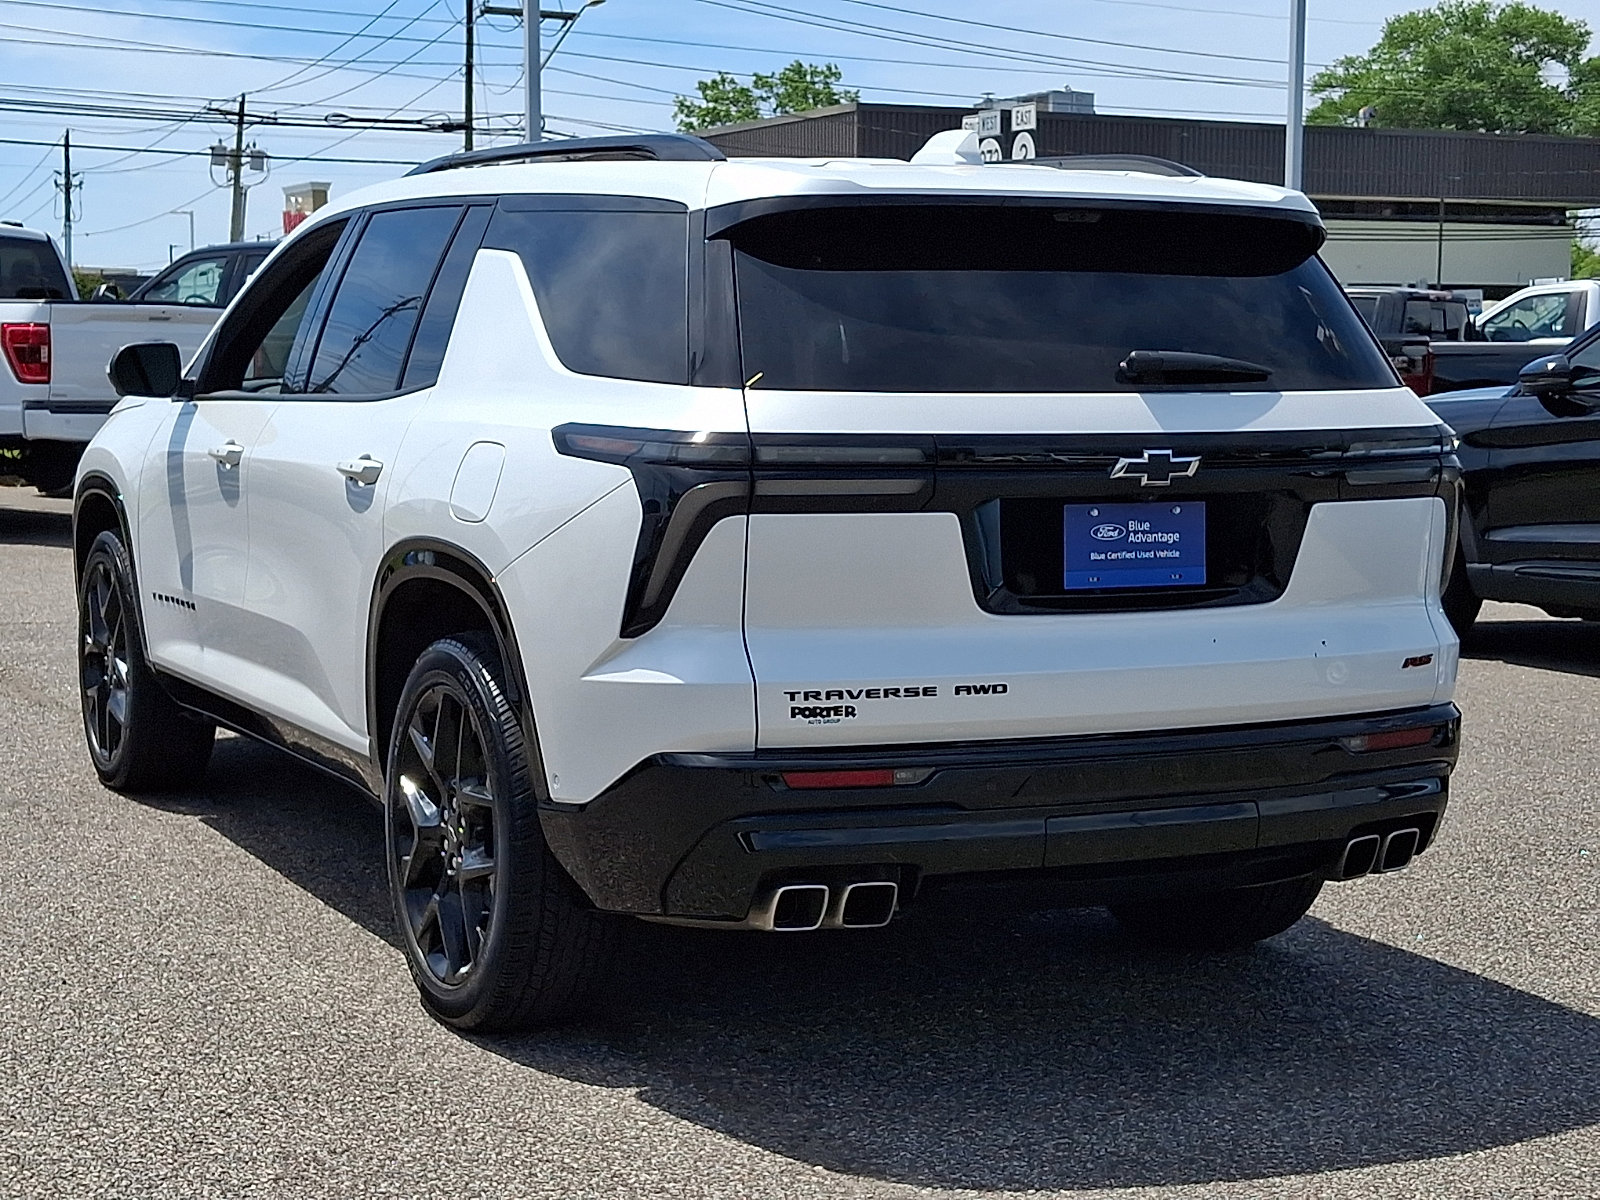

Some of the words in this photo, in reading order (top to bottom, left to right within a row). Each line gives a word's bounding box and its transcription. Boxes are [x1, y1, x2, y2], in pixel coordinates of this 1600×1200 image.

[982, 115, 998, 131] WEST
[1016, 110, 1031, 126] EAST
[1128, 520, 1150, 531] Blue
[1128, 532, 1180, 544] Advantage
[1090, 552, 1106, 560] Blue
[1107, 550, 1136, 560] Certified
[1136, 550, 1154, 559] Used
[1155, 549, 1180, 558] Vehicle
[783, 686, 938, 702] TRAVERSE
[954, 683, 1008, 696] AWD
[790, 705, 857, 719] PORTER
